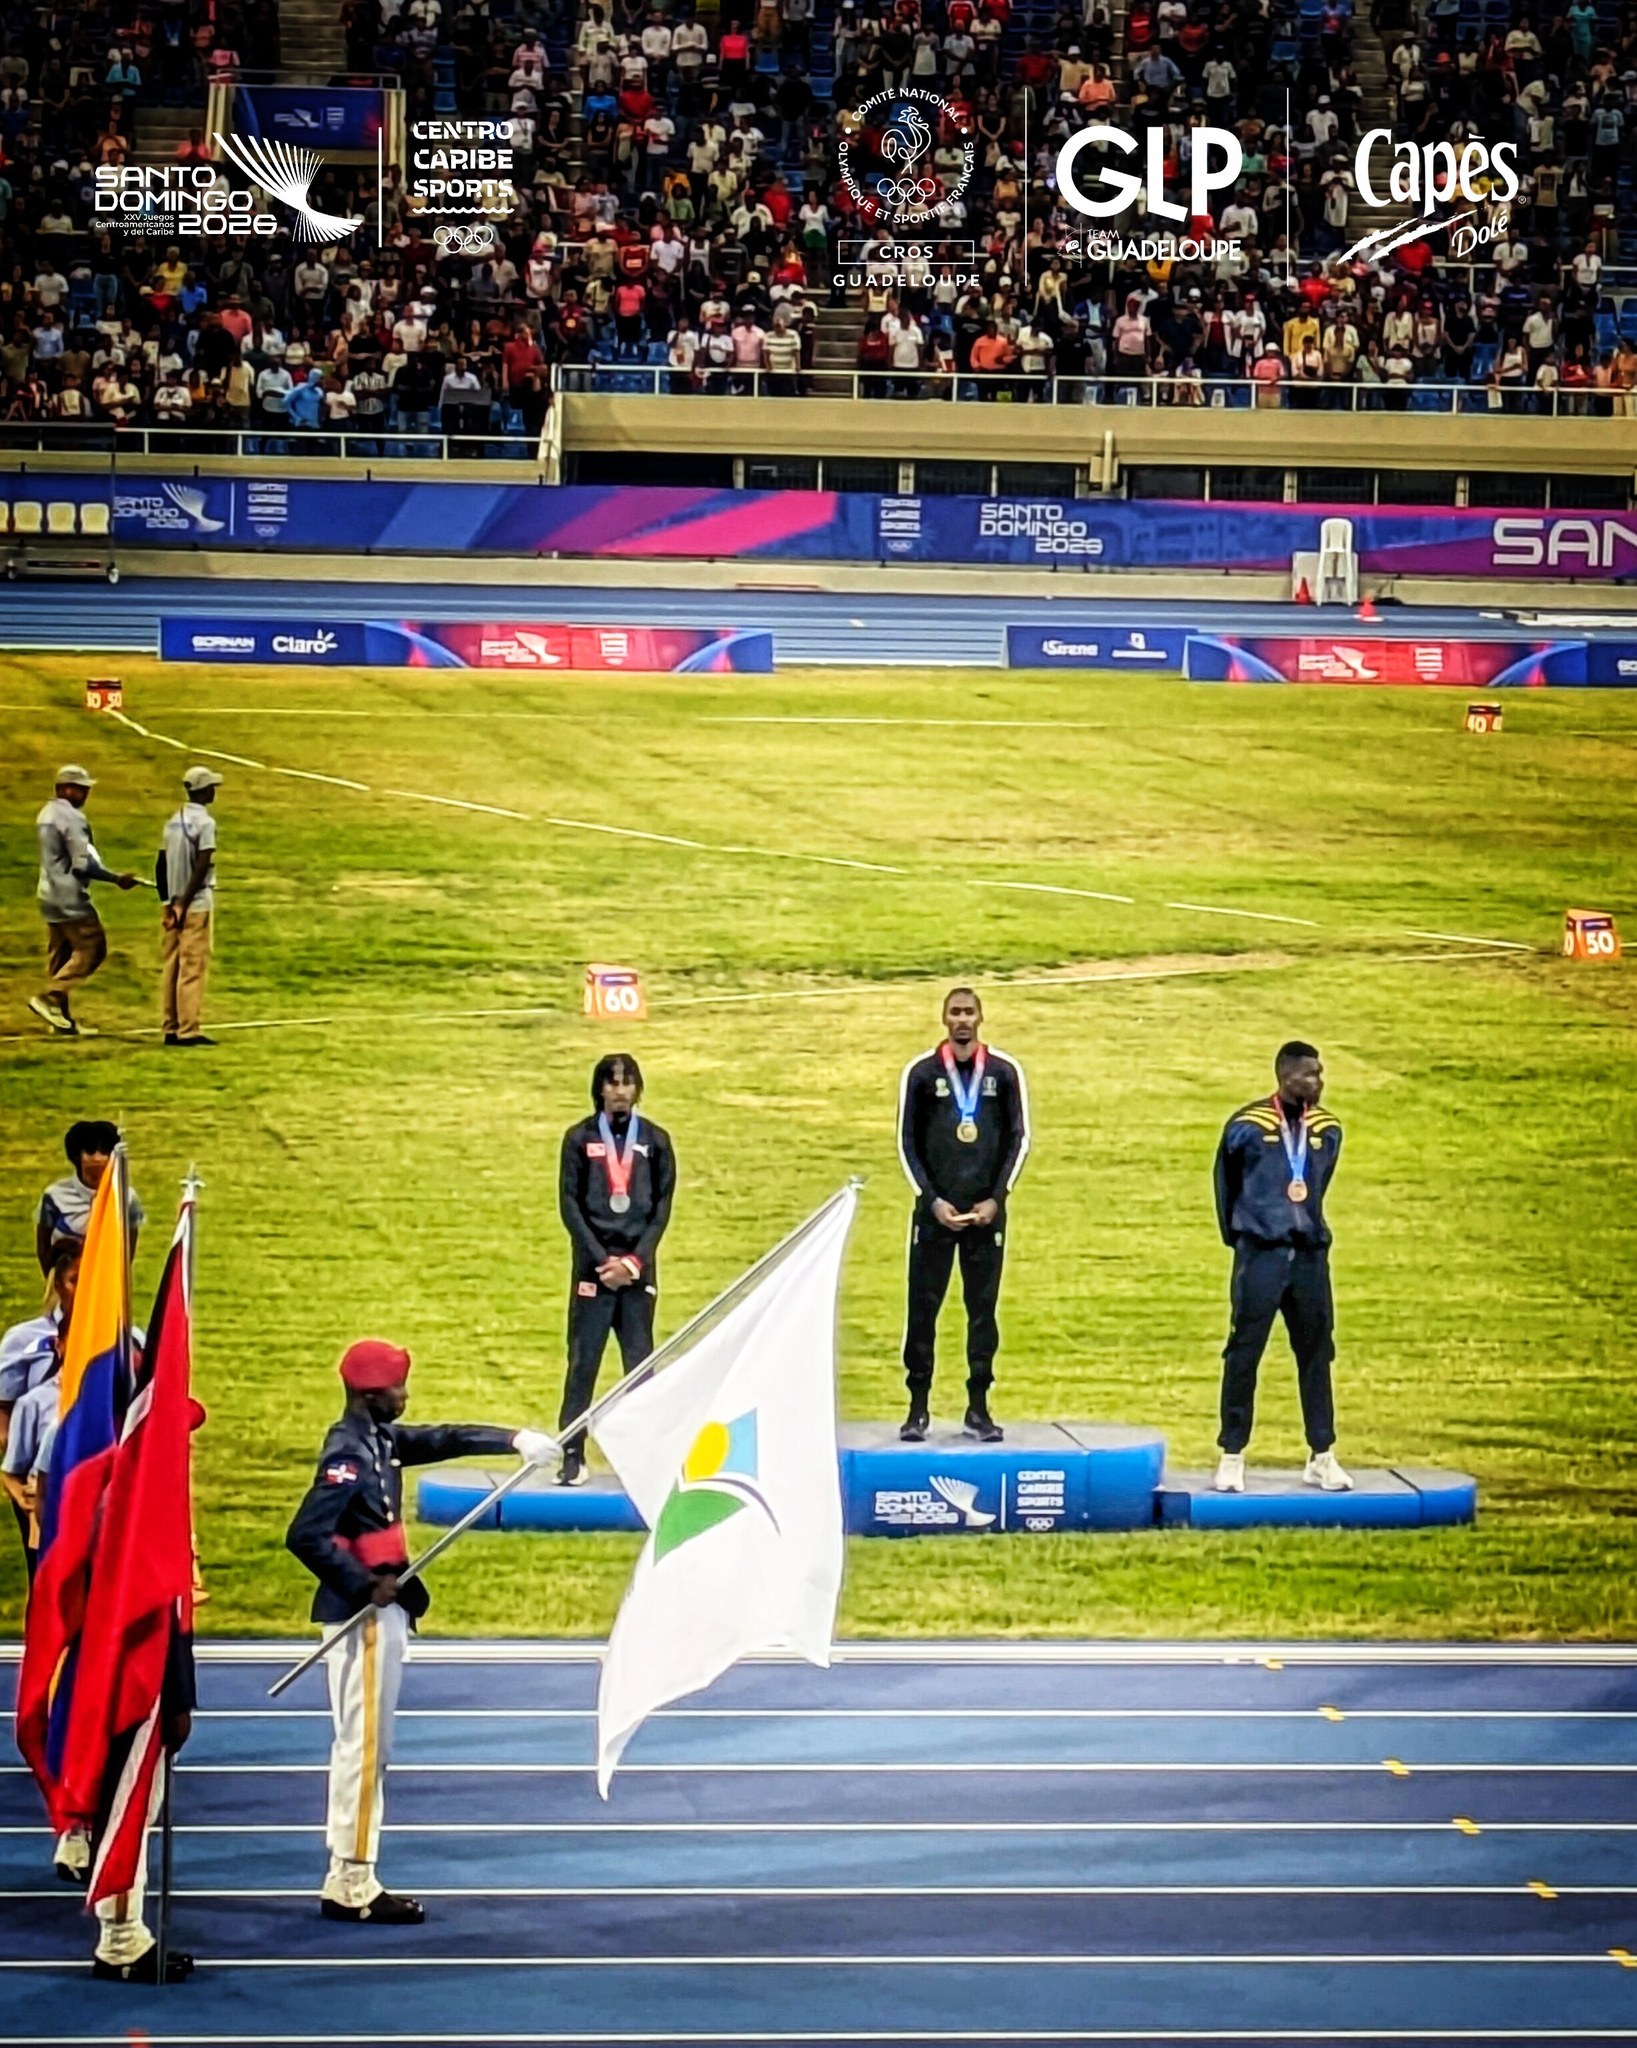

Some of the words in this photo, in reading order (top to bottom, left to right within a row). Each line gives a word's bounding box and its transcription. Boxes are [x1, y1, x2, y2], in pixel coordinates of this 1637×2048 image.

[980, 503, 1063, 520] SANTO
[979, 520, 1087, 537] DOMINGO
[272, 635, 328, 653] Claro
[1586, 930, 1614, 955] 50
[605, 986, 638, 1012] 60
